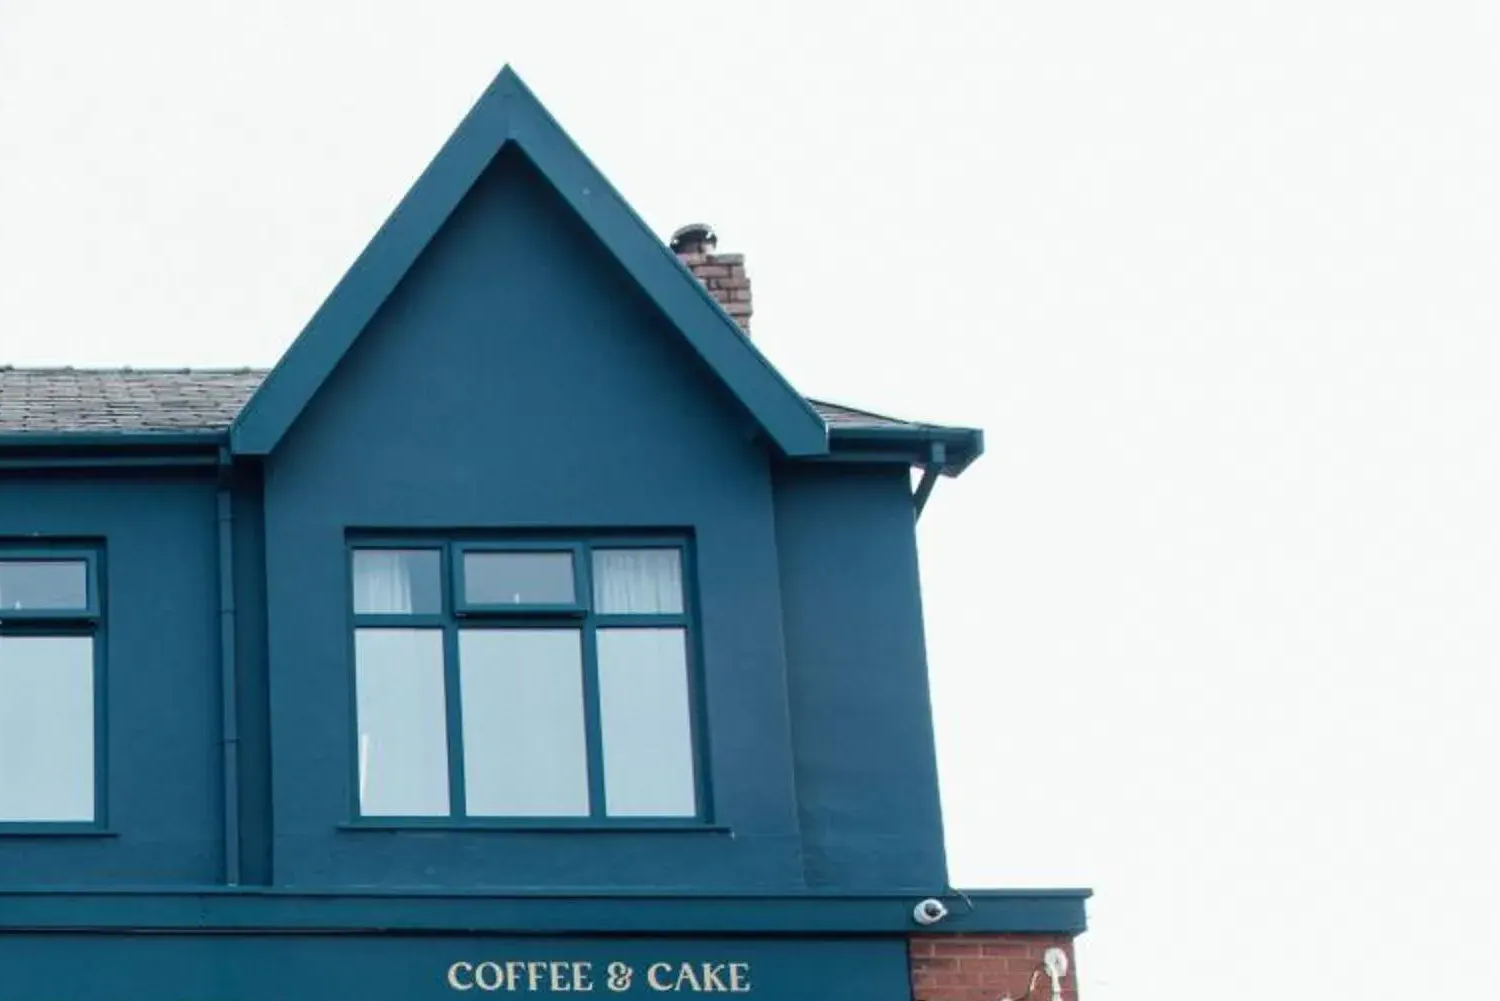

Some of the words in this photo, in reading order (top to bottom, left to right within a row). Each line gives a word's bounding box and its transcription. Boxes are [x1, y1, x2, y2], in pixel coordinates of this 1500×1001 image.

[447, 961, 594, 992] COFFEE
[607, 961, 634, 992] &
[647, 962, 750, 992] CAKE
